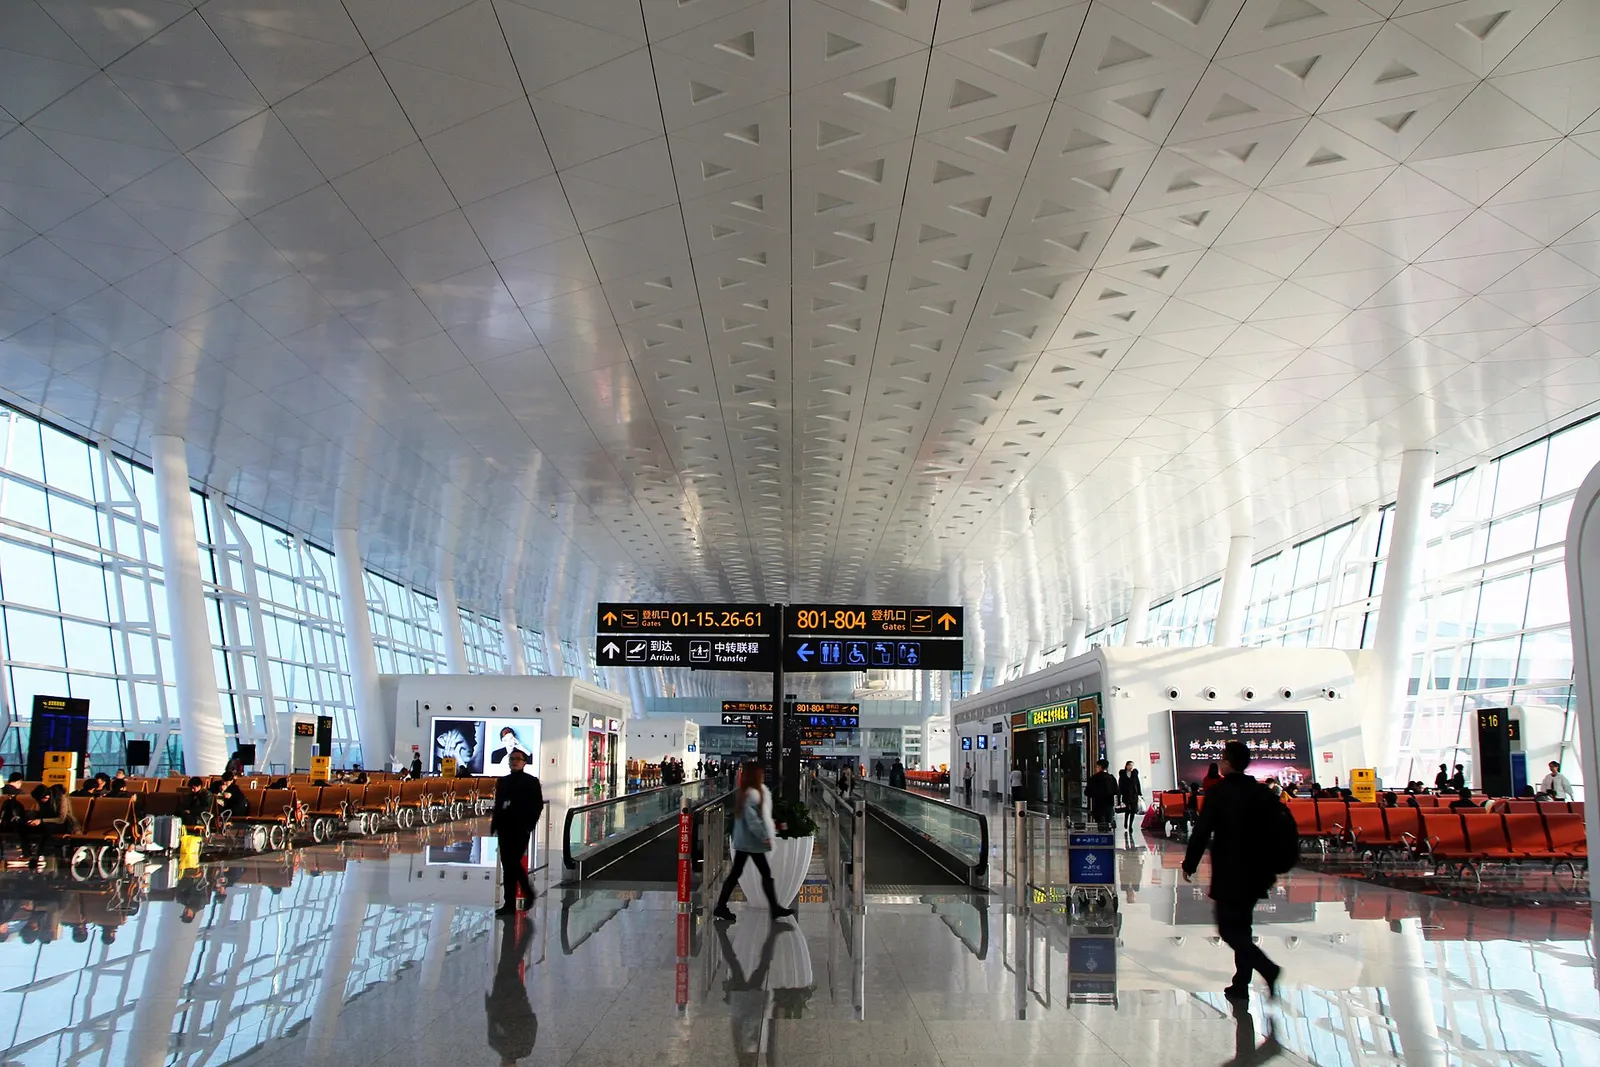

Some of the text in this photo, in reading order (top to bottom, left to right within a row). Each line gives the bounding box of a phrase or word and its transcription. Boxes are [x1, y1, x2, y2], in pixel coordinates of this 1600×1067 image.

[642, 610, 670, 620] 登机口
[797, 610, 866, 629] 801-804
[871, 609, 906, 621] 登机口
[882, 622, 906, 631] Gates
[650, 640, 673, 652] 到达
[714, 642, 759, 654] 中转联程
[650, 653, 681, 662] Arrivals
[714, 654, 748, 663] Transfer
[796, 704, 824, 713] 801-804
[1488, 714, 1499, 727] 16
[681, 815, 689, 852] 禁止通行
